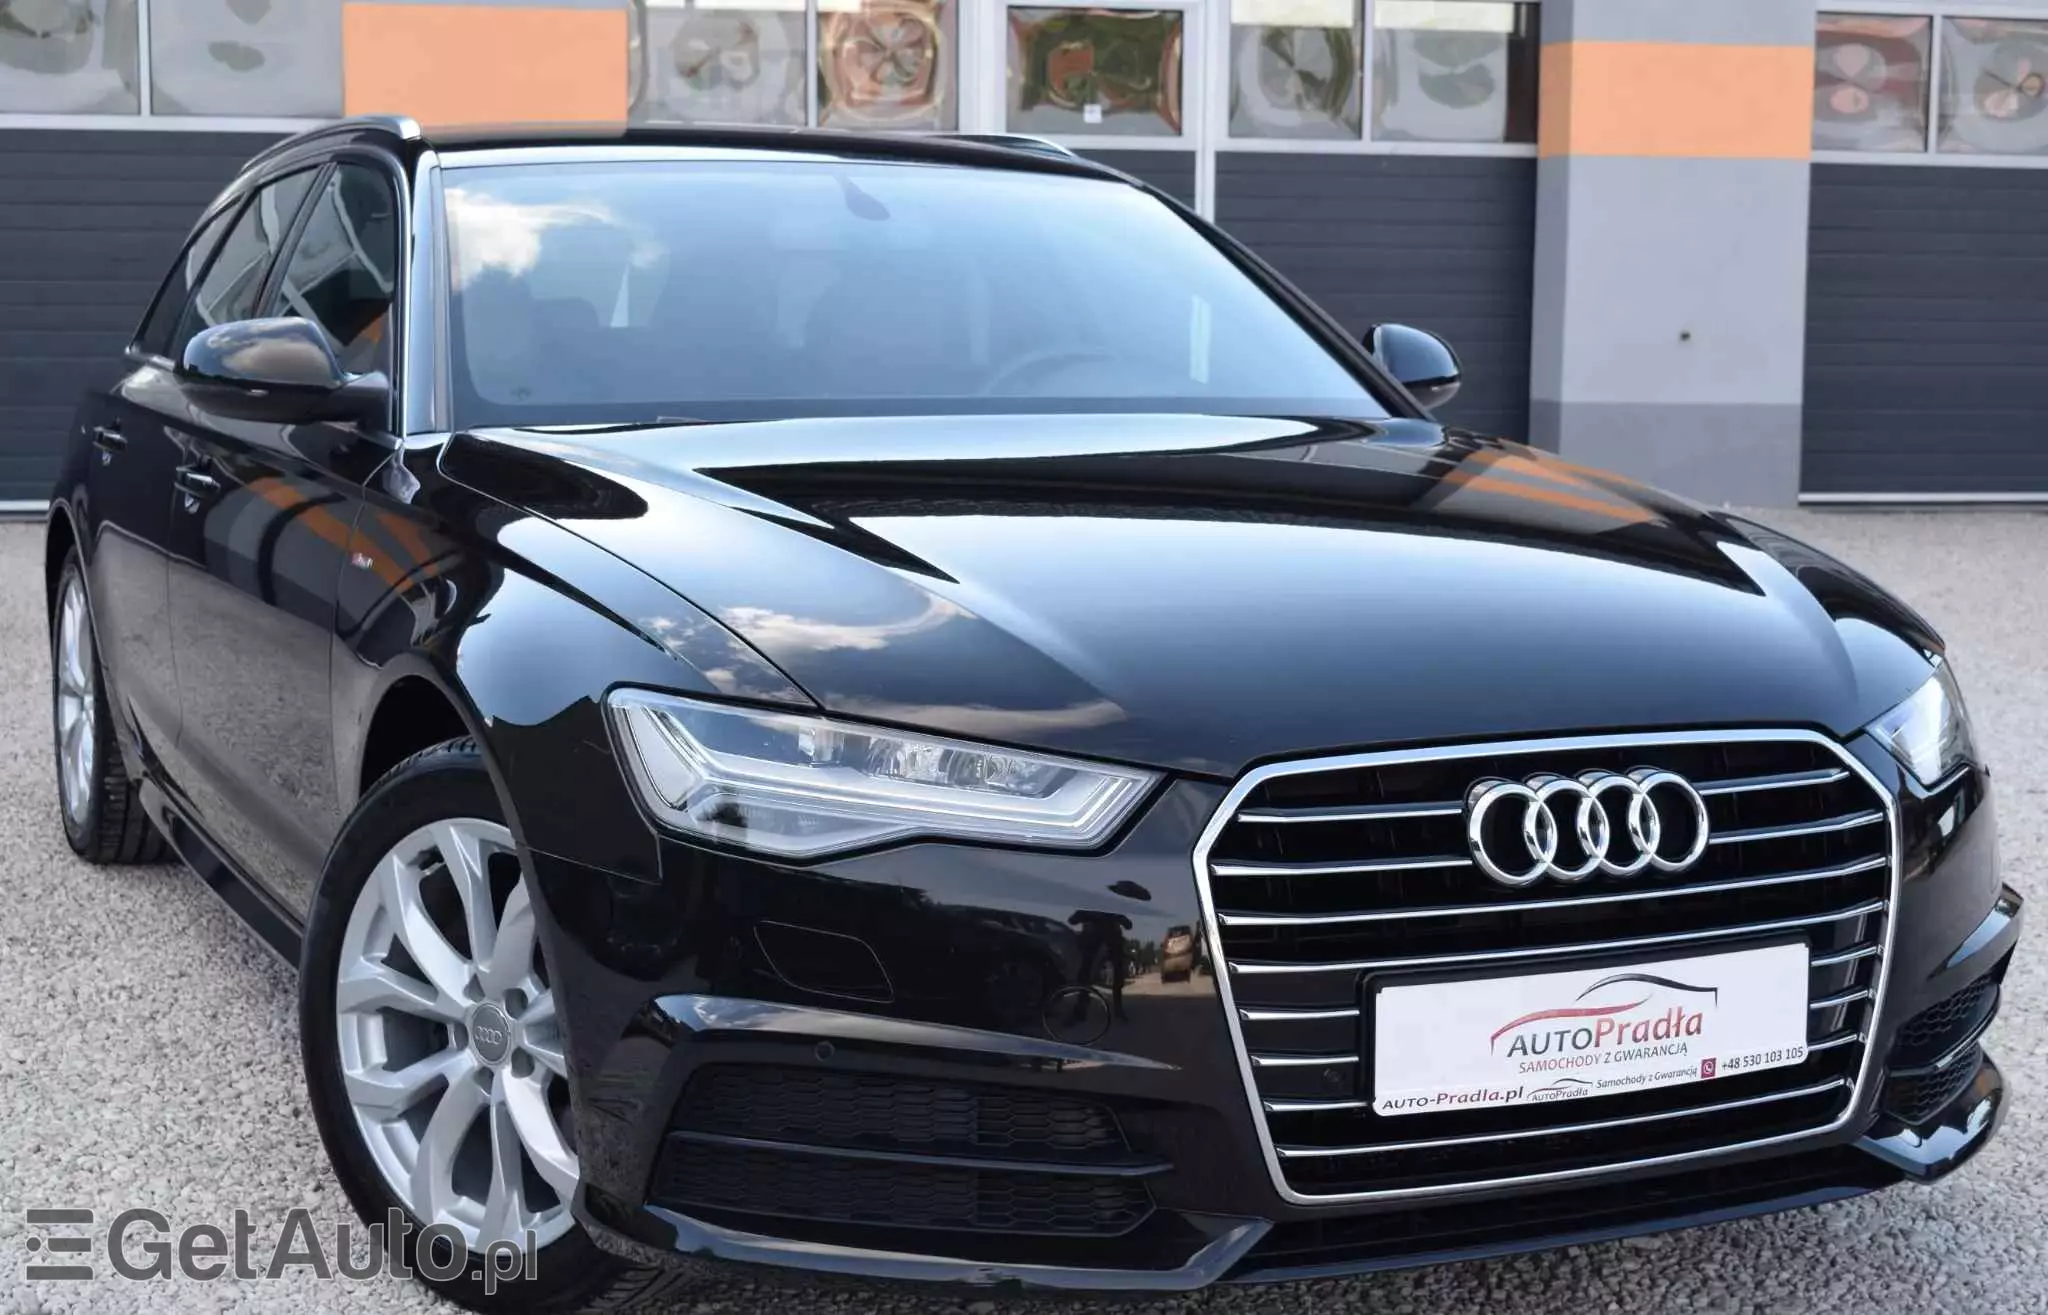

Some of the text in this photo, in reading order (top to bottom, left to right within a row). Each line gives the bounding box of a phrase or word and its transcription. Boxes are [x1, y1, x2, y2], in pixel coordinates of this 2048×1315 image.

[1507, 1006, 1703, 1057] AUTOPradła
[1518, 1042, 1688, 1074] SAMOCHODY Z GWARANCJĄ
[1721, 1046, 1804, 1071] +48 530 103 105
[1597, 1071, 1646, 1089] Samochody
[1654, 1066, 1698, 1082] Gwarancją
